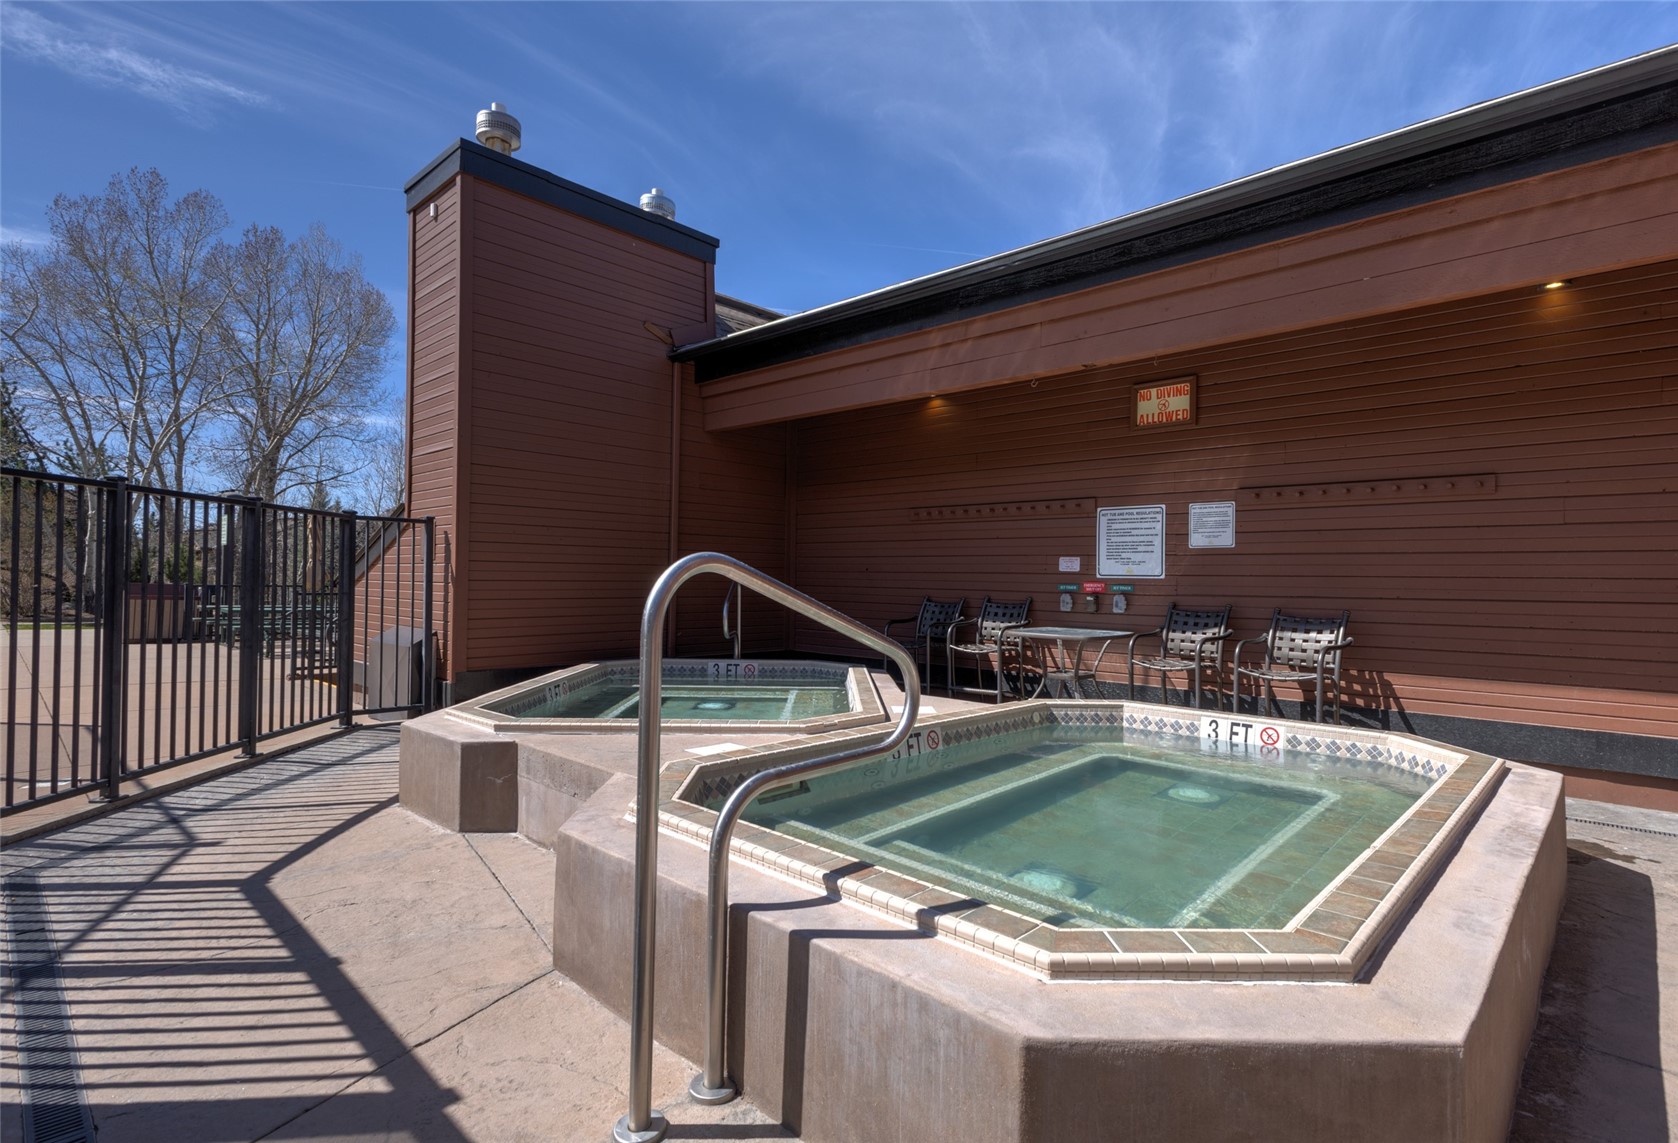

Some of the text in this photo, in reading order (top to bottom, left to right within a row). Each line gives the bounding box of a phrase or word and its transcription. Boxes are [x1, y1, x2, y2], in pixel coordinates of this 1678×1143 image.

[1139, 385, 1189, 402] NO DIVING
[1139, 409, 1189, 425] ALLOWED
[713, 663, 740, 676] 3 FT
[1207, 719, 1253, 743] 3 FT
[907, 733, 921, 756] FT
